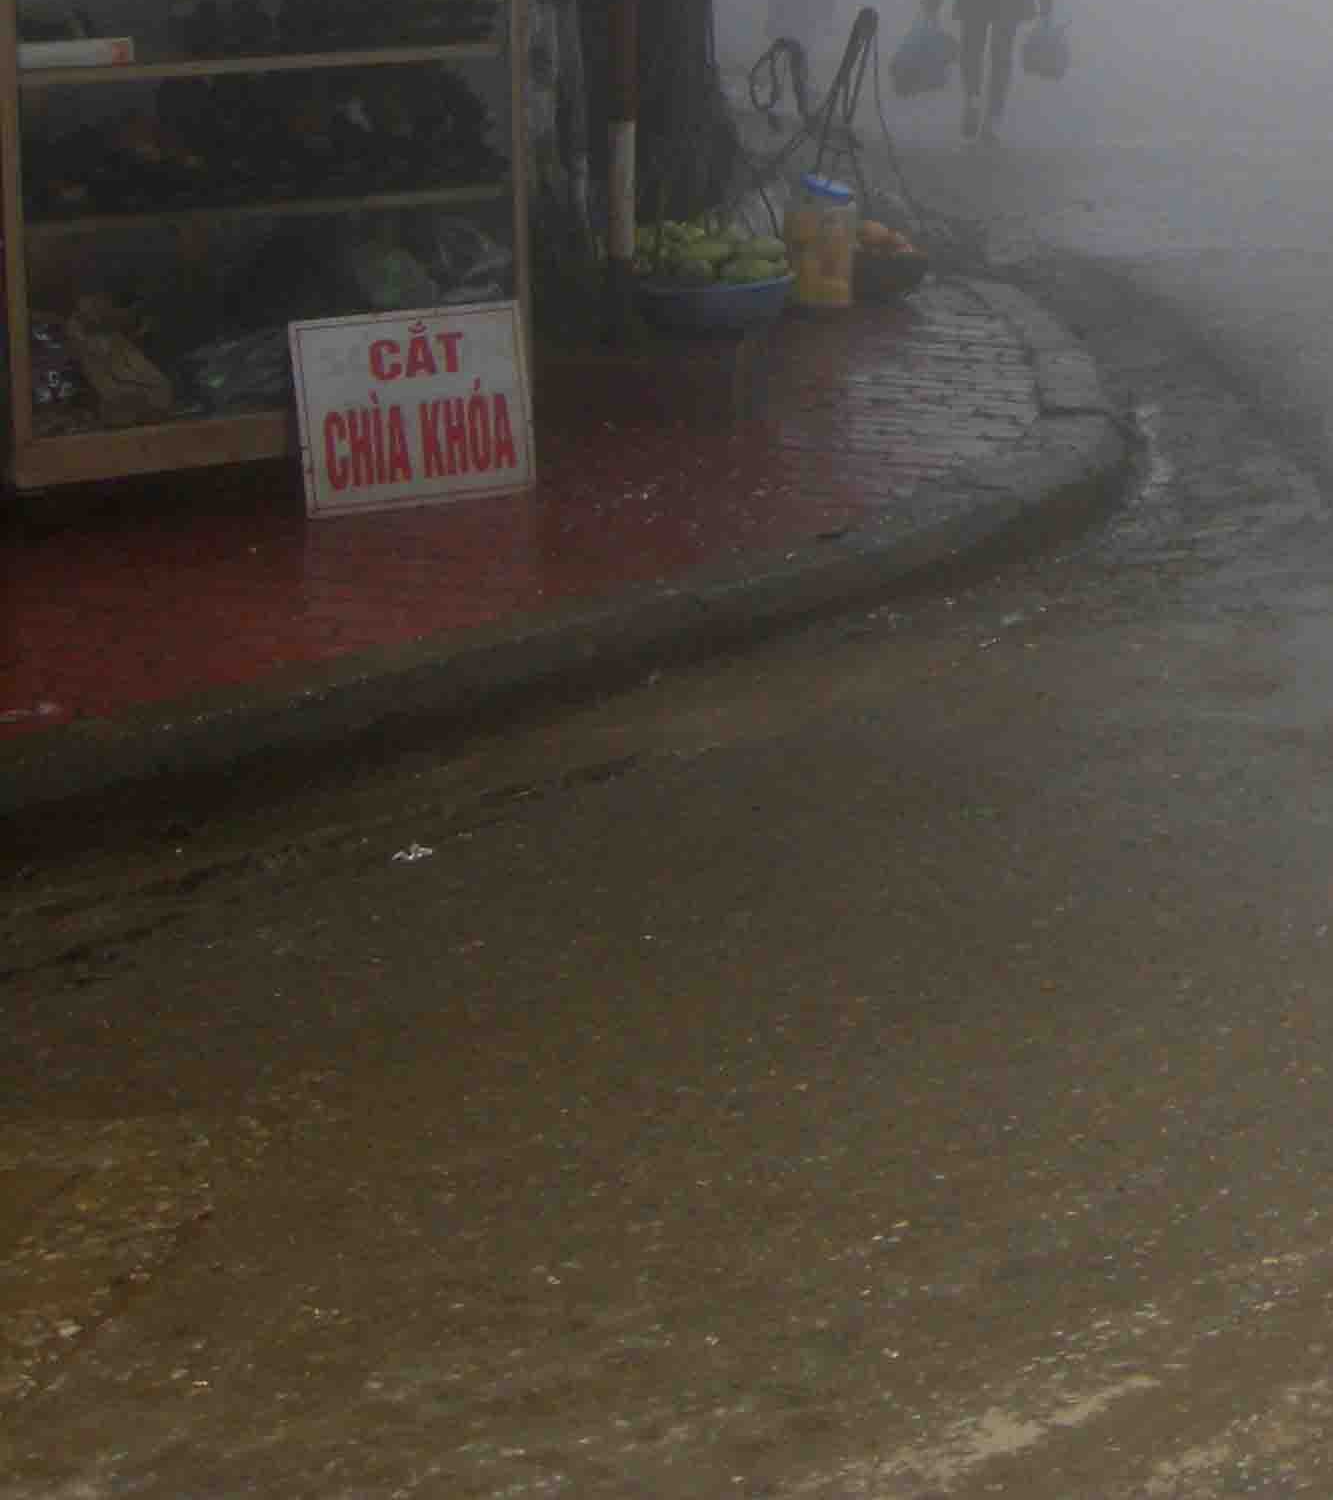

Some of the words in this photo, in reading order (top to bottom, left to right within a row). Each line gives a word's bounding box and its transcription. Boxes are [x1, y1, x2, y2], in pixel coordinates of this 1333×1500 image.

[367, 321, 465, 381] CẮT
[323, 390, 414, 490] CHÌA
[416, 374, 517, 479] KHÓA
